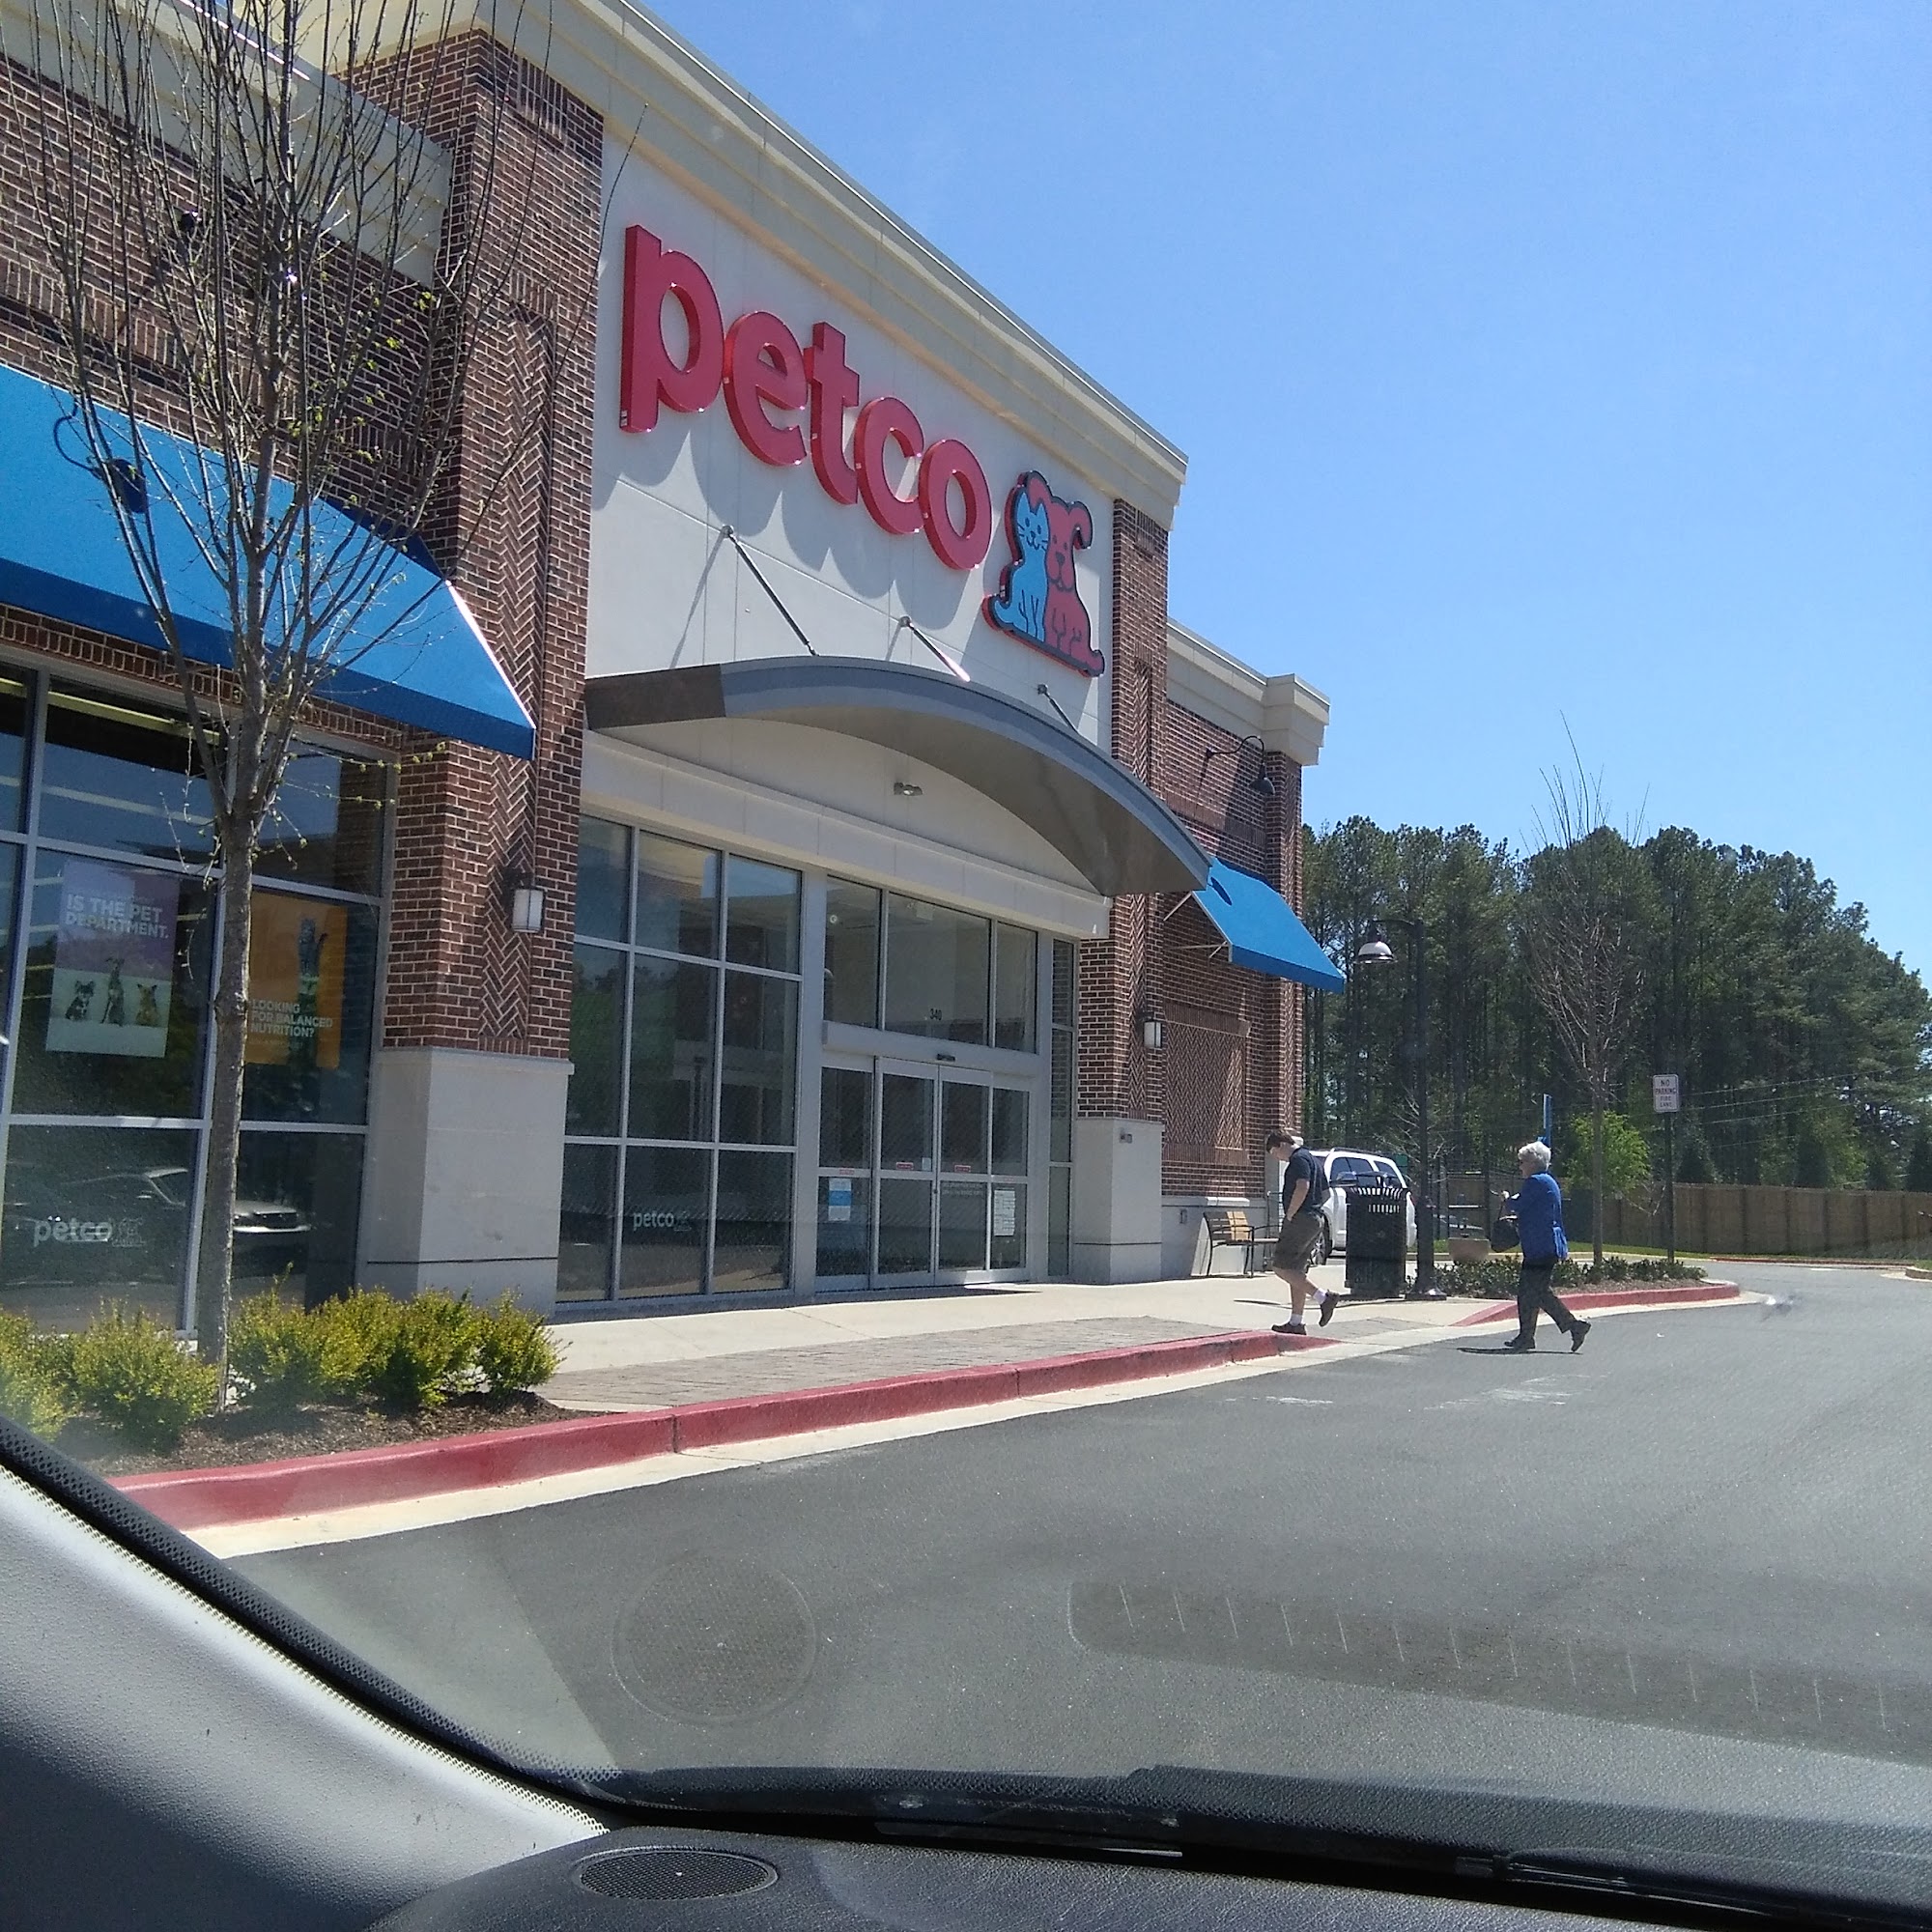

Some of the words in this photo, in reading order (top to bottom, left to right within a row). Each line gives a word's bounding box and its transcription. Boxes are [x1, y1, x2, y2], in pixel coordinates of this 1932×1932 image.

[619, 224, 993, 571] petco
[67, 894, 85, 913] IS
[90, 897, 127, 918] THE
[128, 902, 164, 924] PET
[64, 911, 170, 940] DEPARTMENT.
[251, 999, 301, 1014] LOOKING
[251, 1010, 274, 1024] FOR
[276, 1012, 333, 1029] BALANCED
[251, 1023, 315, 1038] NUTRITION?
[34, 1217, 113, 1248] petco
[633, 1209, 675, 1233] petco
